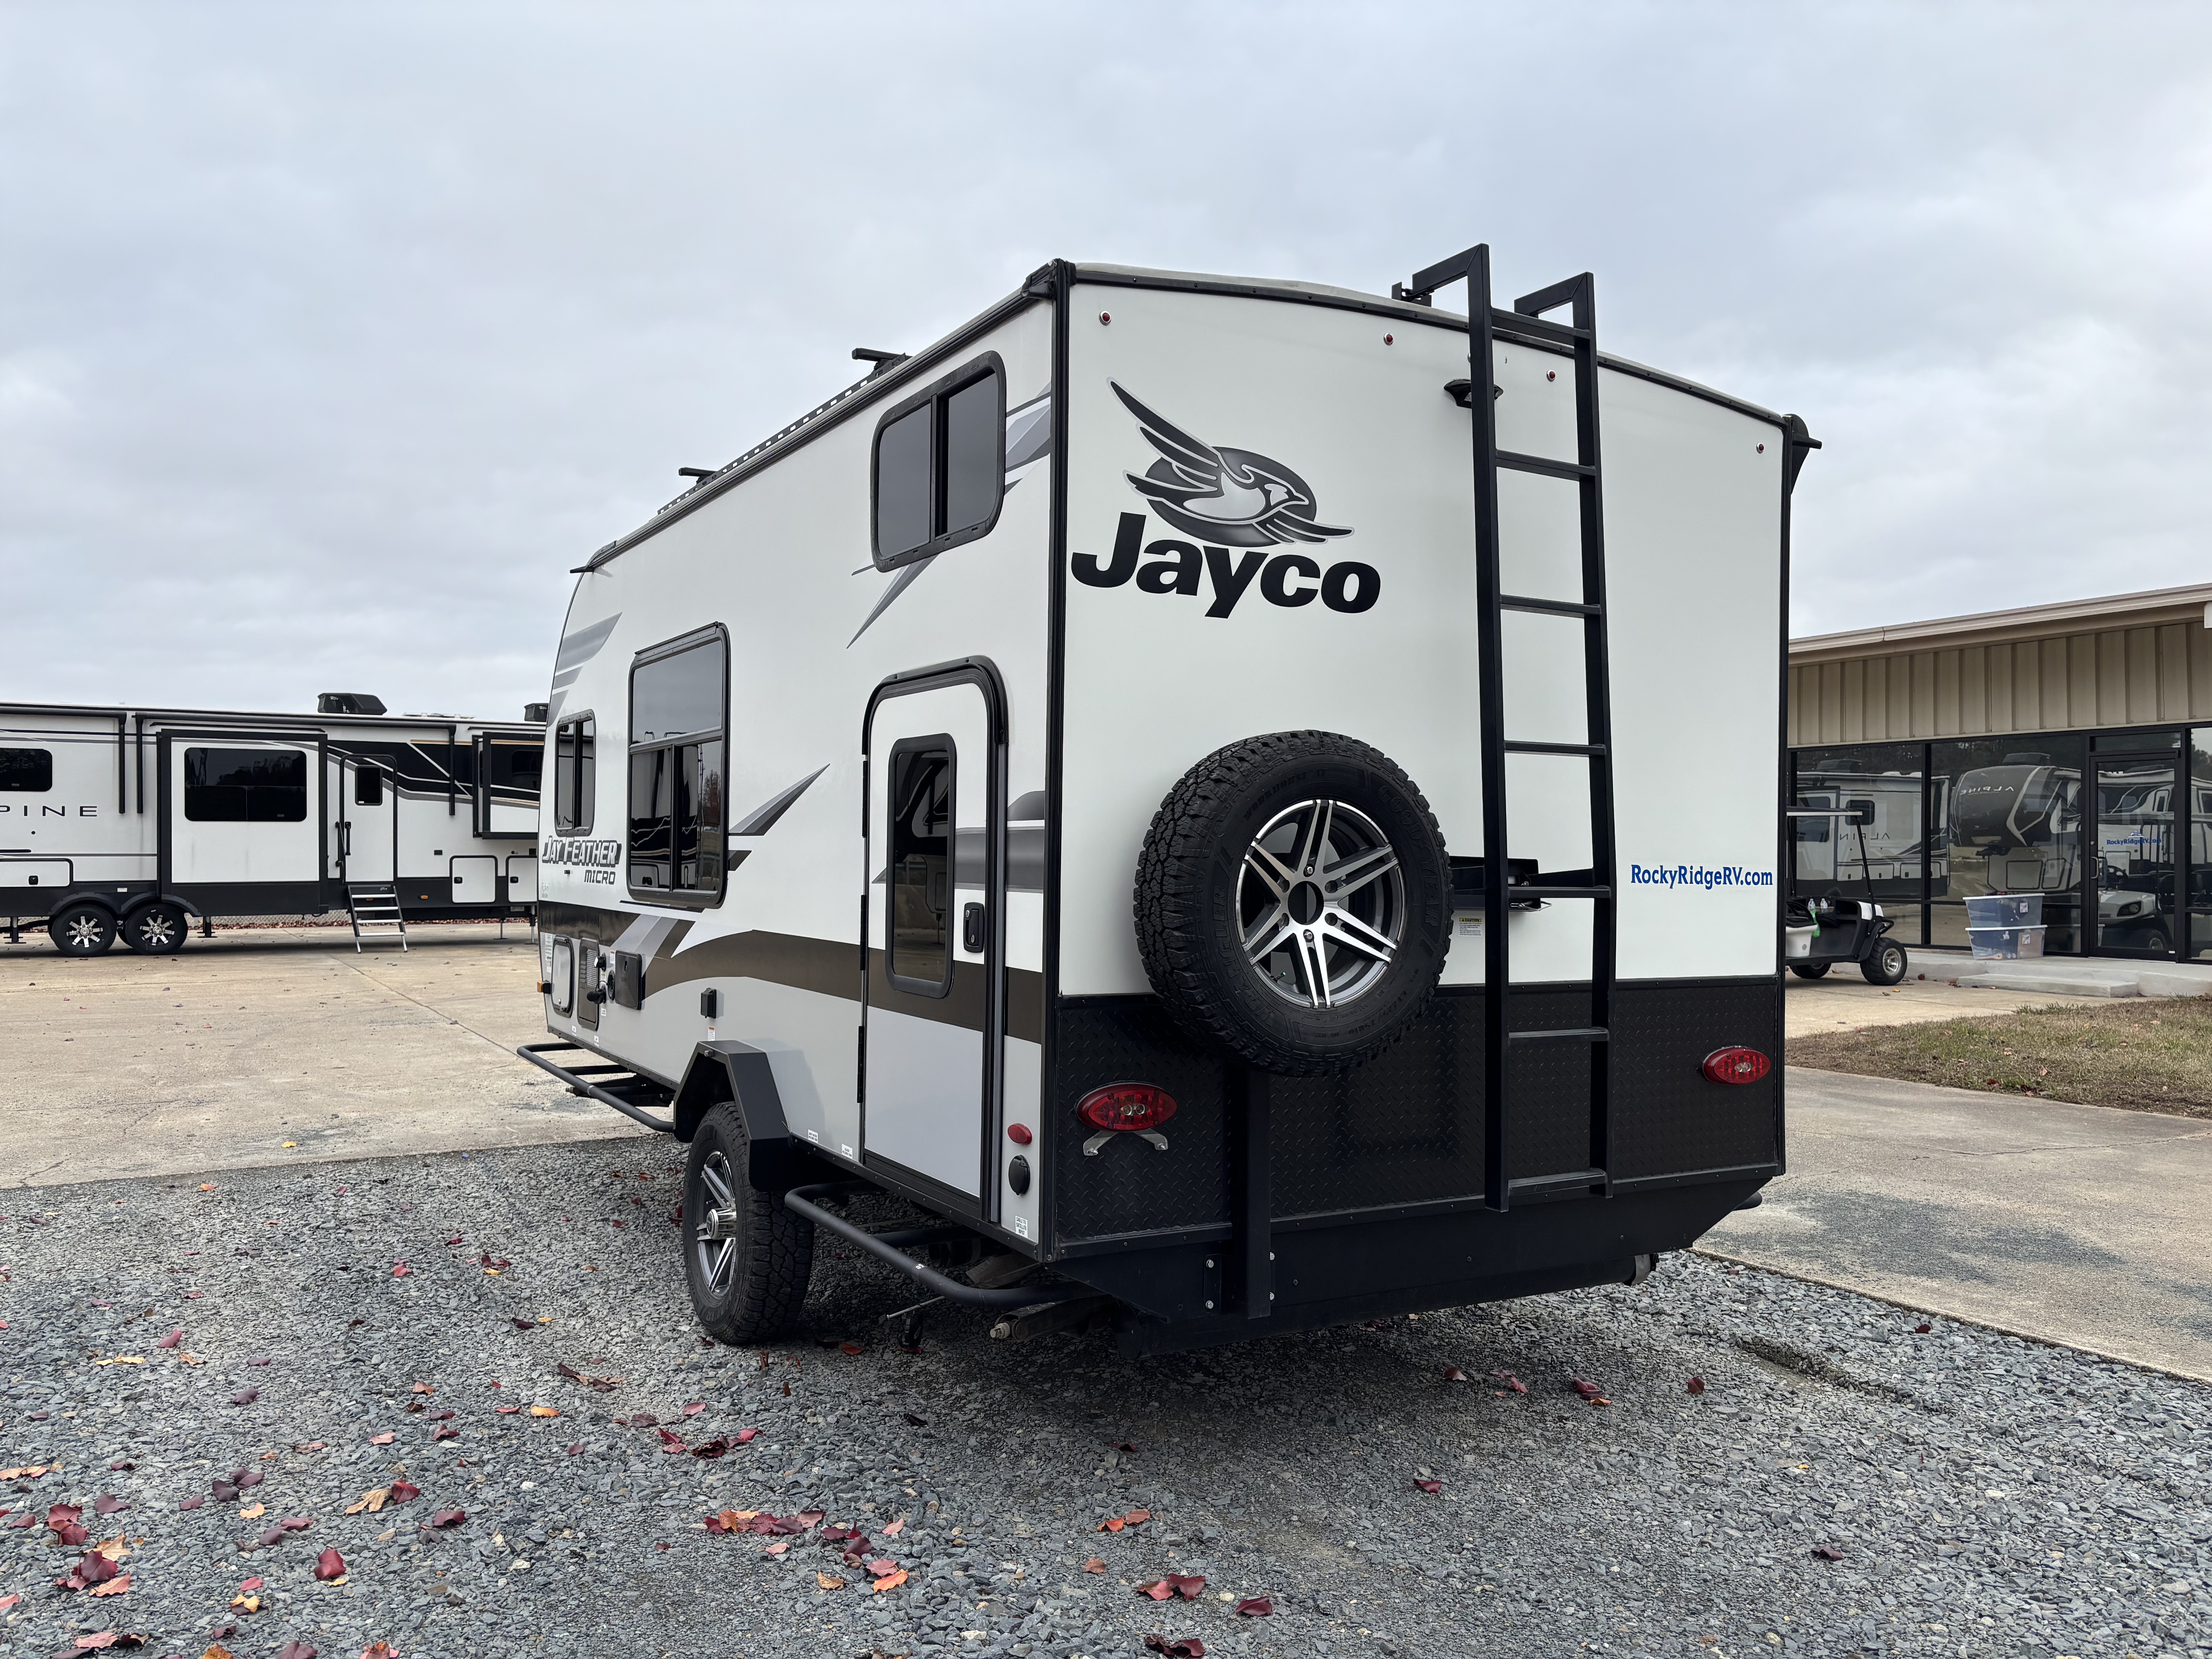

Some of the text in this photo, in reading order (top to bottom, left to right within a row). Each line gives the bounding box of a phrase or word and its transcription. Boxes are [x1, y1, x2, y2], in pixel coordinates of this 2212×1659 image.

[1071, 512, 1381, 619] Jayco
[542, 836, 618, 867] JAY FEATHER
[584, 870, 616, 884] MICRO
[1631, 864, 1773, 890] RockyRidgeRV.com
